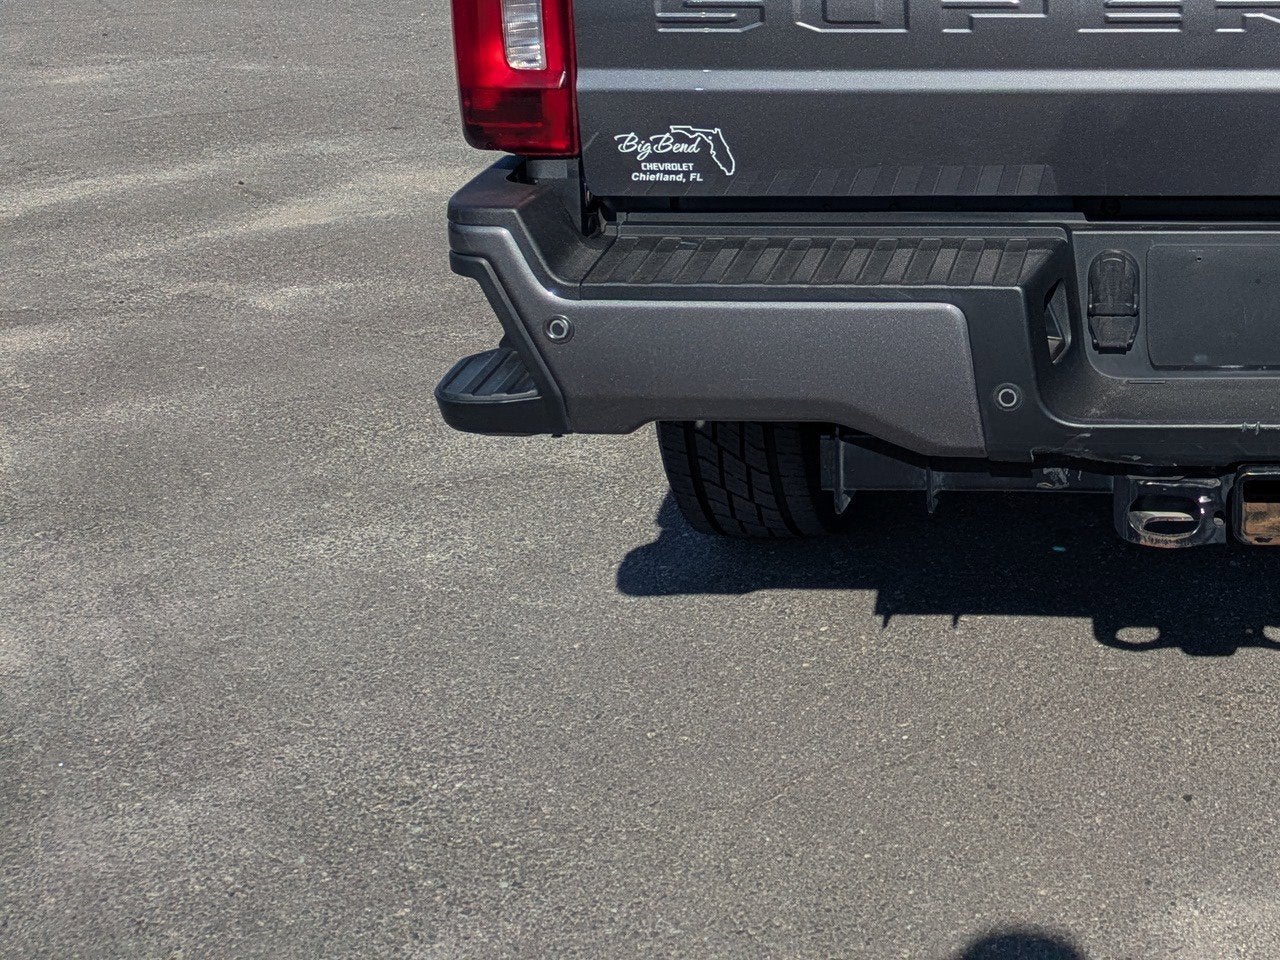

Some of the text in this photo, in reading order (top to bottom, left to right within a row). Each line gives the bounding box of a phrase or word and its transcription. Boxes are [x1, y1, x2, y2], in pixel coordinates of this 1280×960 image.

[614, 132, 701, 161] Big Bend
[641, 162, 694, 171] CHEVROLET
[631, 172, 704, 183] Chiefland, FL
